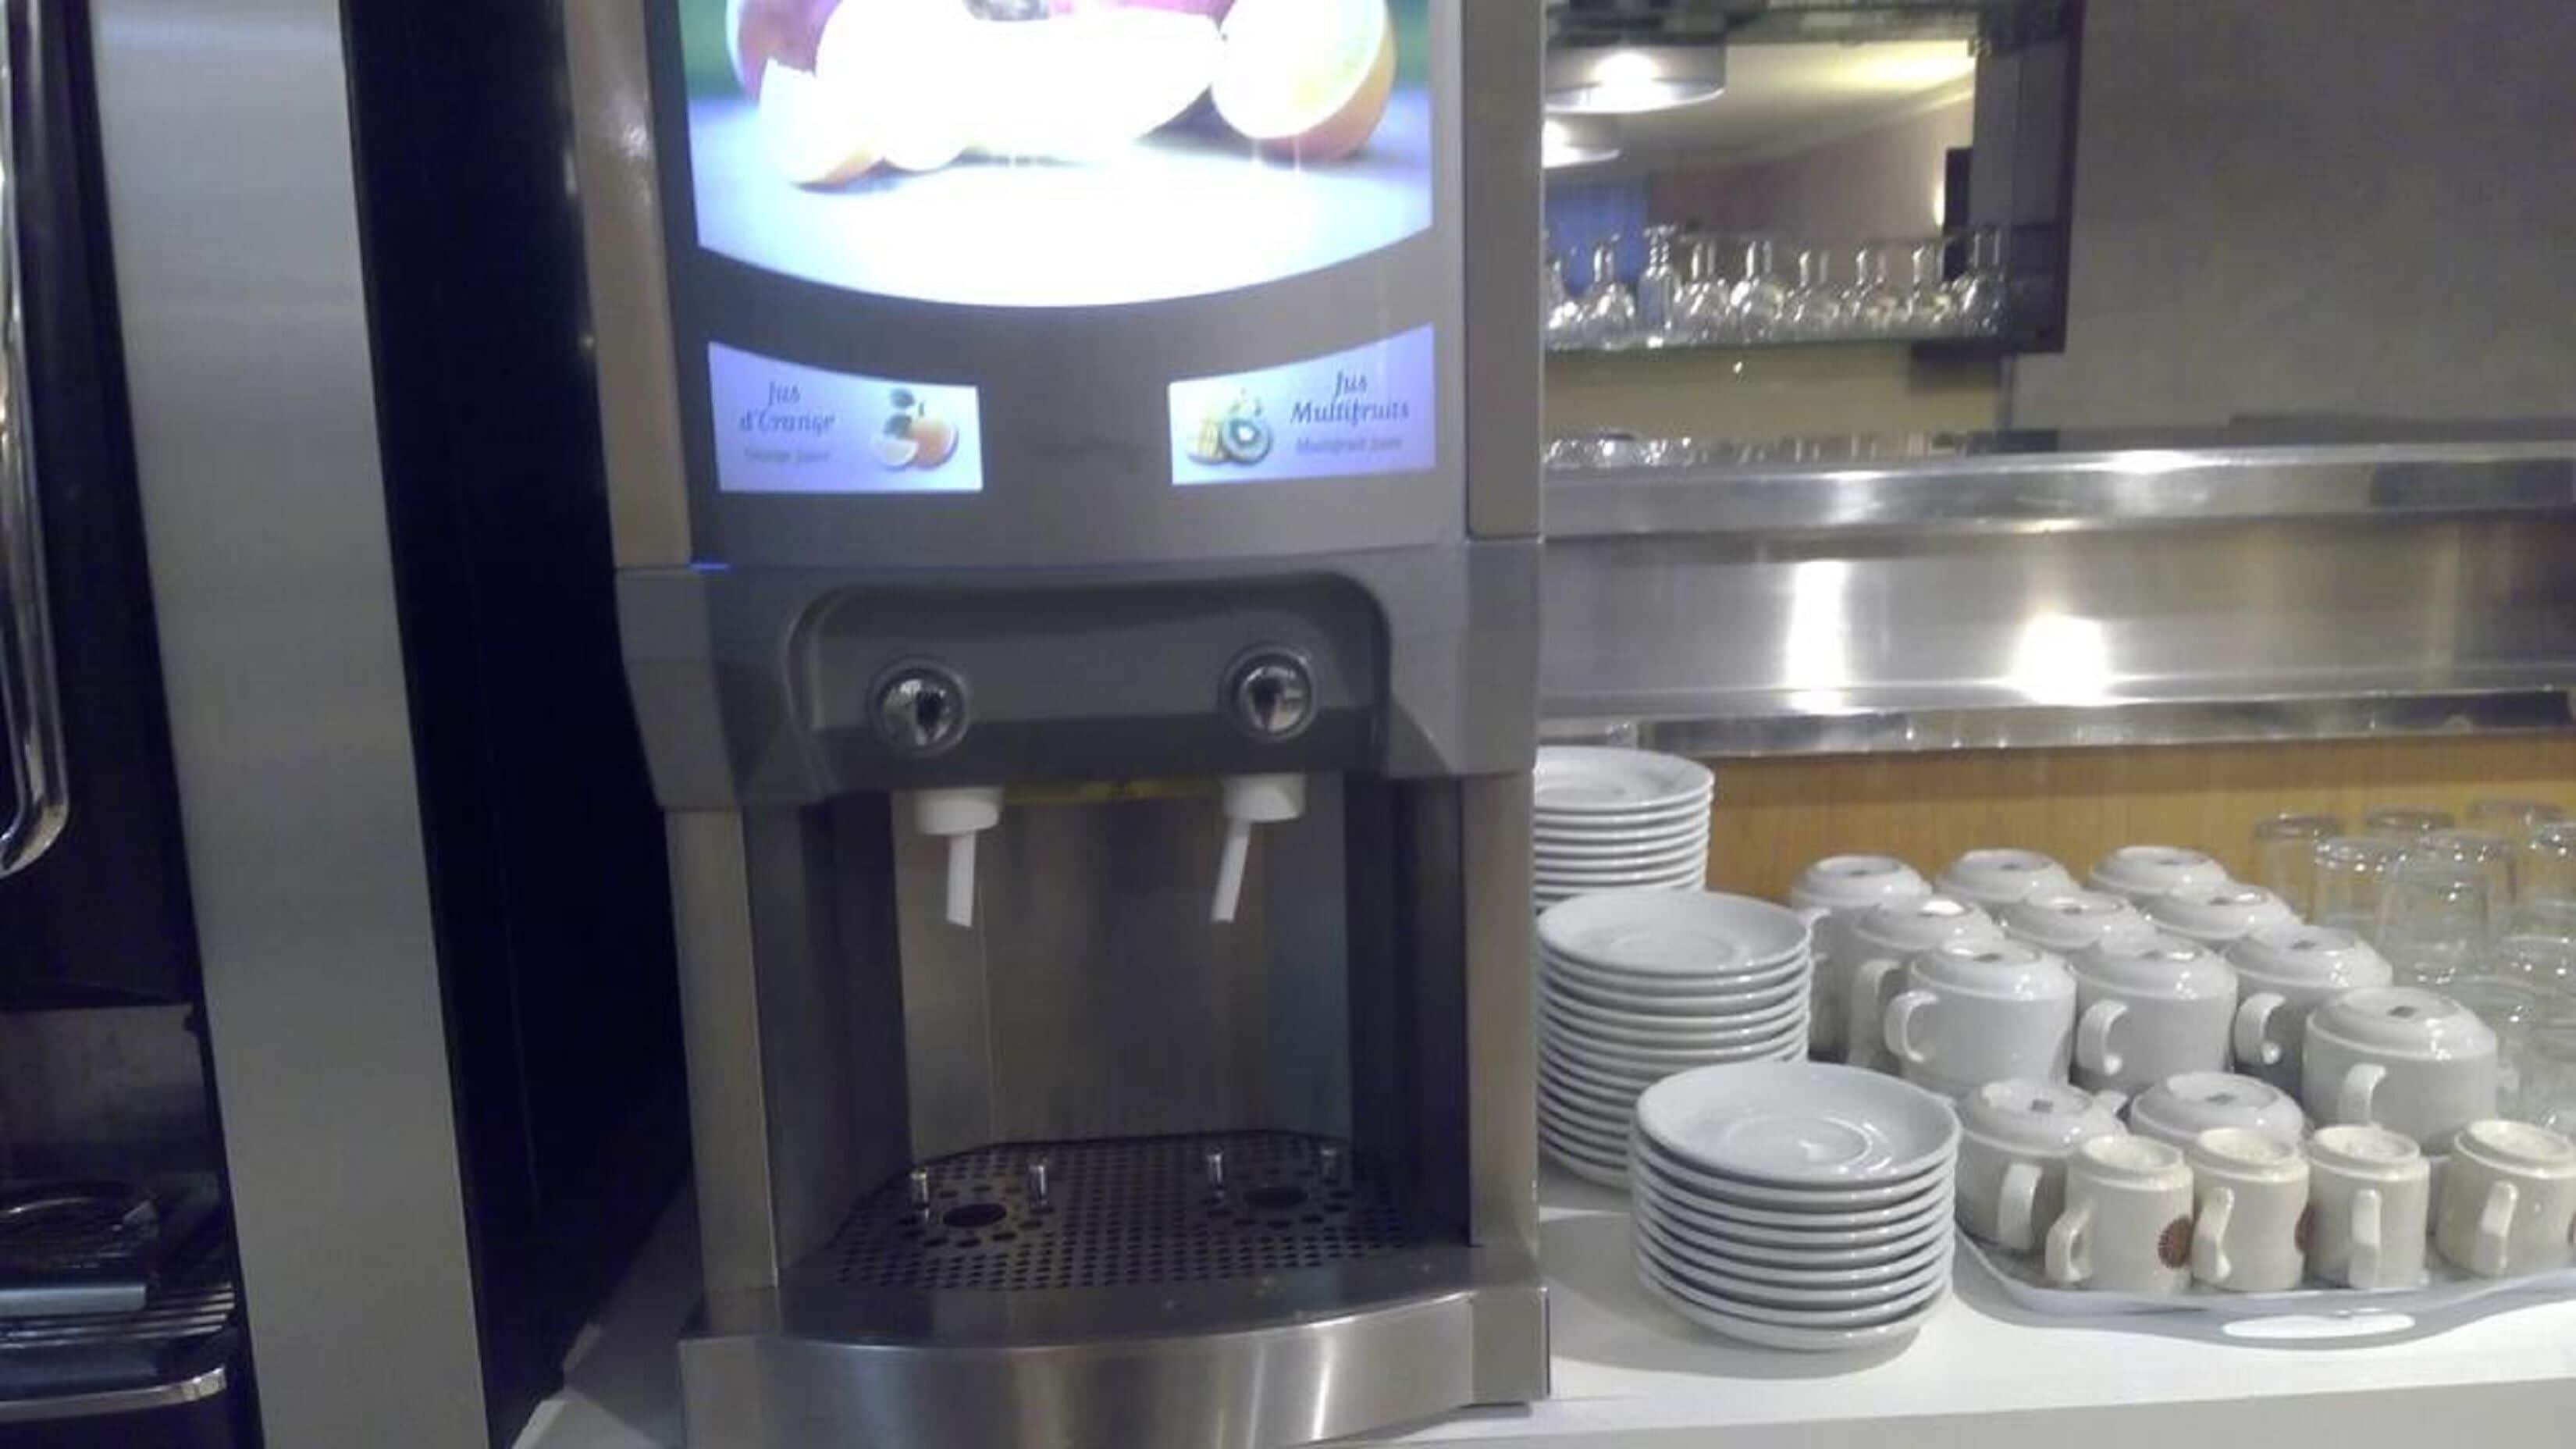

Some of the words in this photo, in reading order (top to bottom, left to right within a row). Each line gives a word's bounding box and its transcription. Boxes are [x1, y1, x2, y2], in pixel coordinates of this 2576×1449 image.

[767, 381, 802, 407] Jus
[1332, 369, 1367, 398] Jus
[1290, 400, 1410, 427] Multifruits
